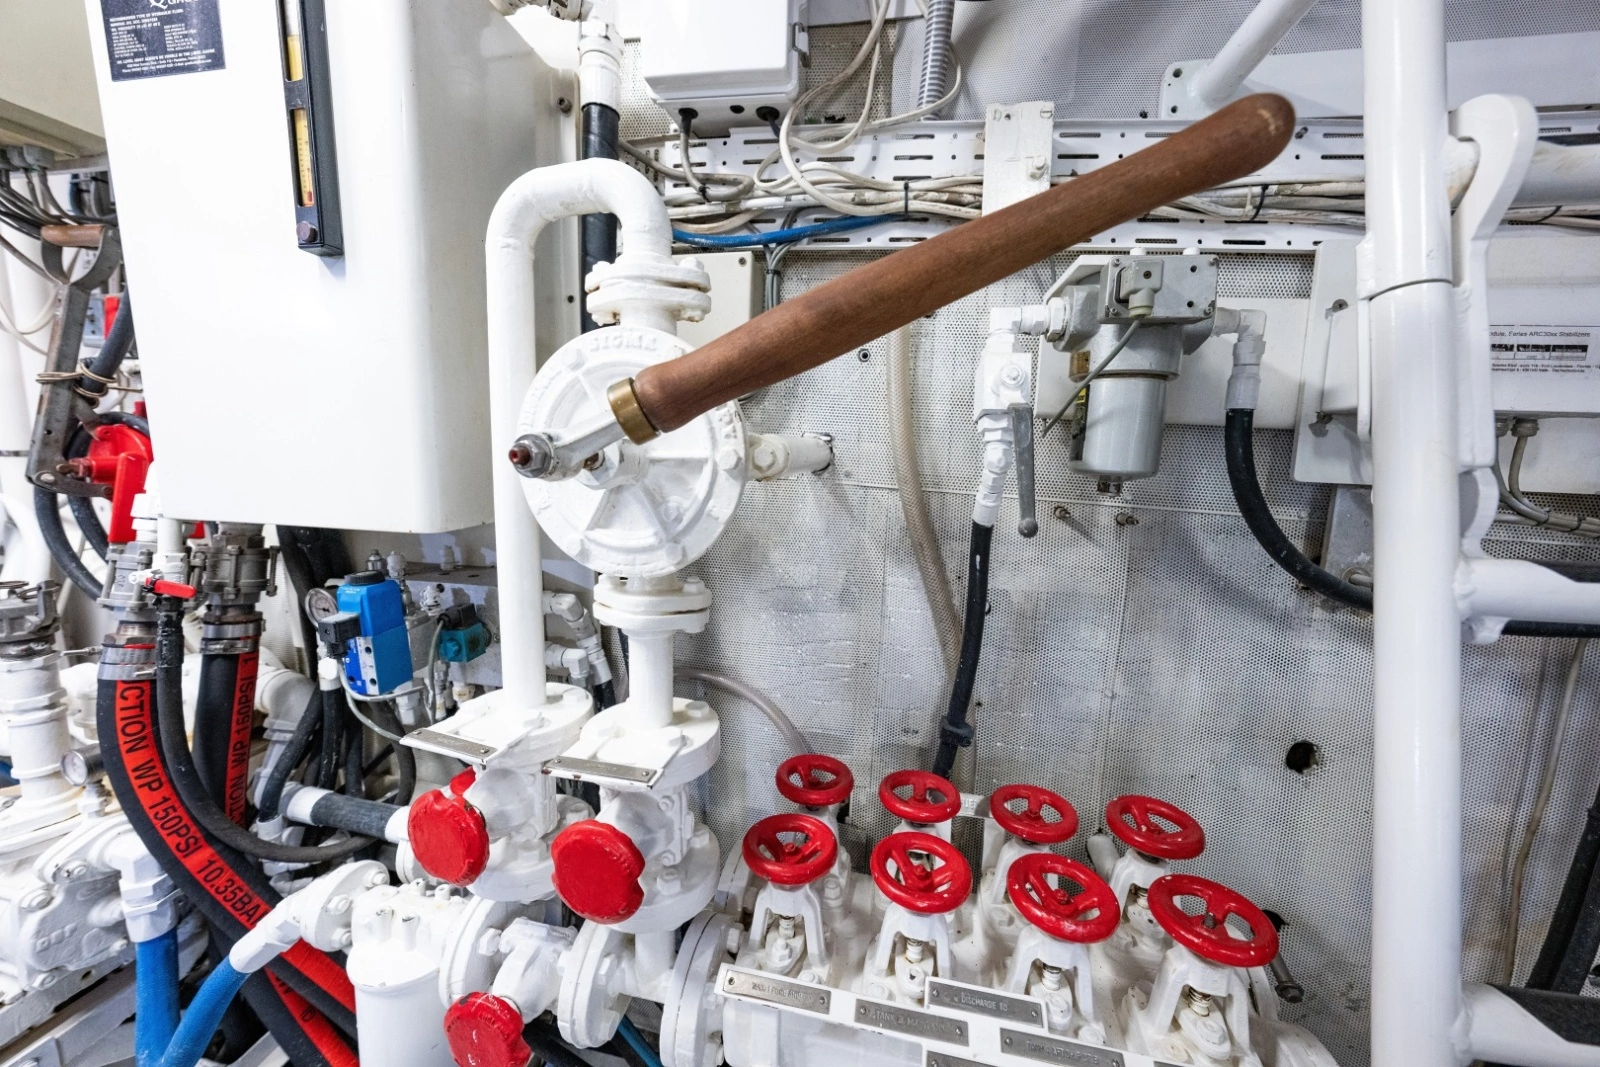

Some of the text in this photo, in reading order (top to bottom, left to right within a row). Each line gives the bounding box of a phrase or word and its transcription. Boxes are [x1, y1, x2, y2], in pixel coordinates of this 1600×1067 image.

[236, 677, 255, 736] 150PSI
[232, 741, 247, 769] WP
[132, 758, 163, 793] WP
[148, 796, 203, 859] 150PSI
